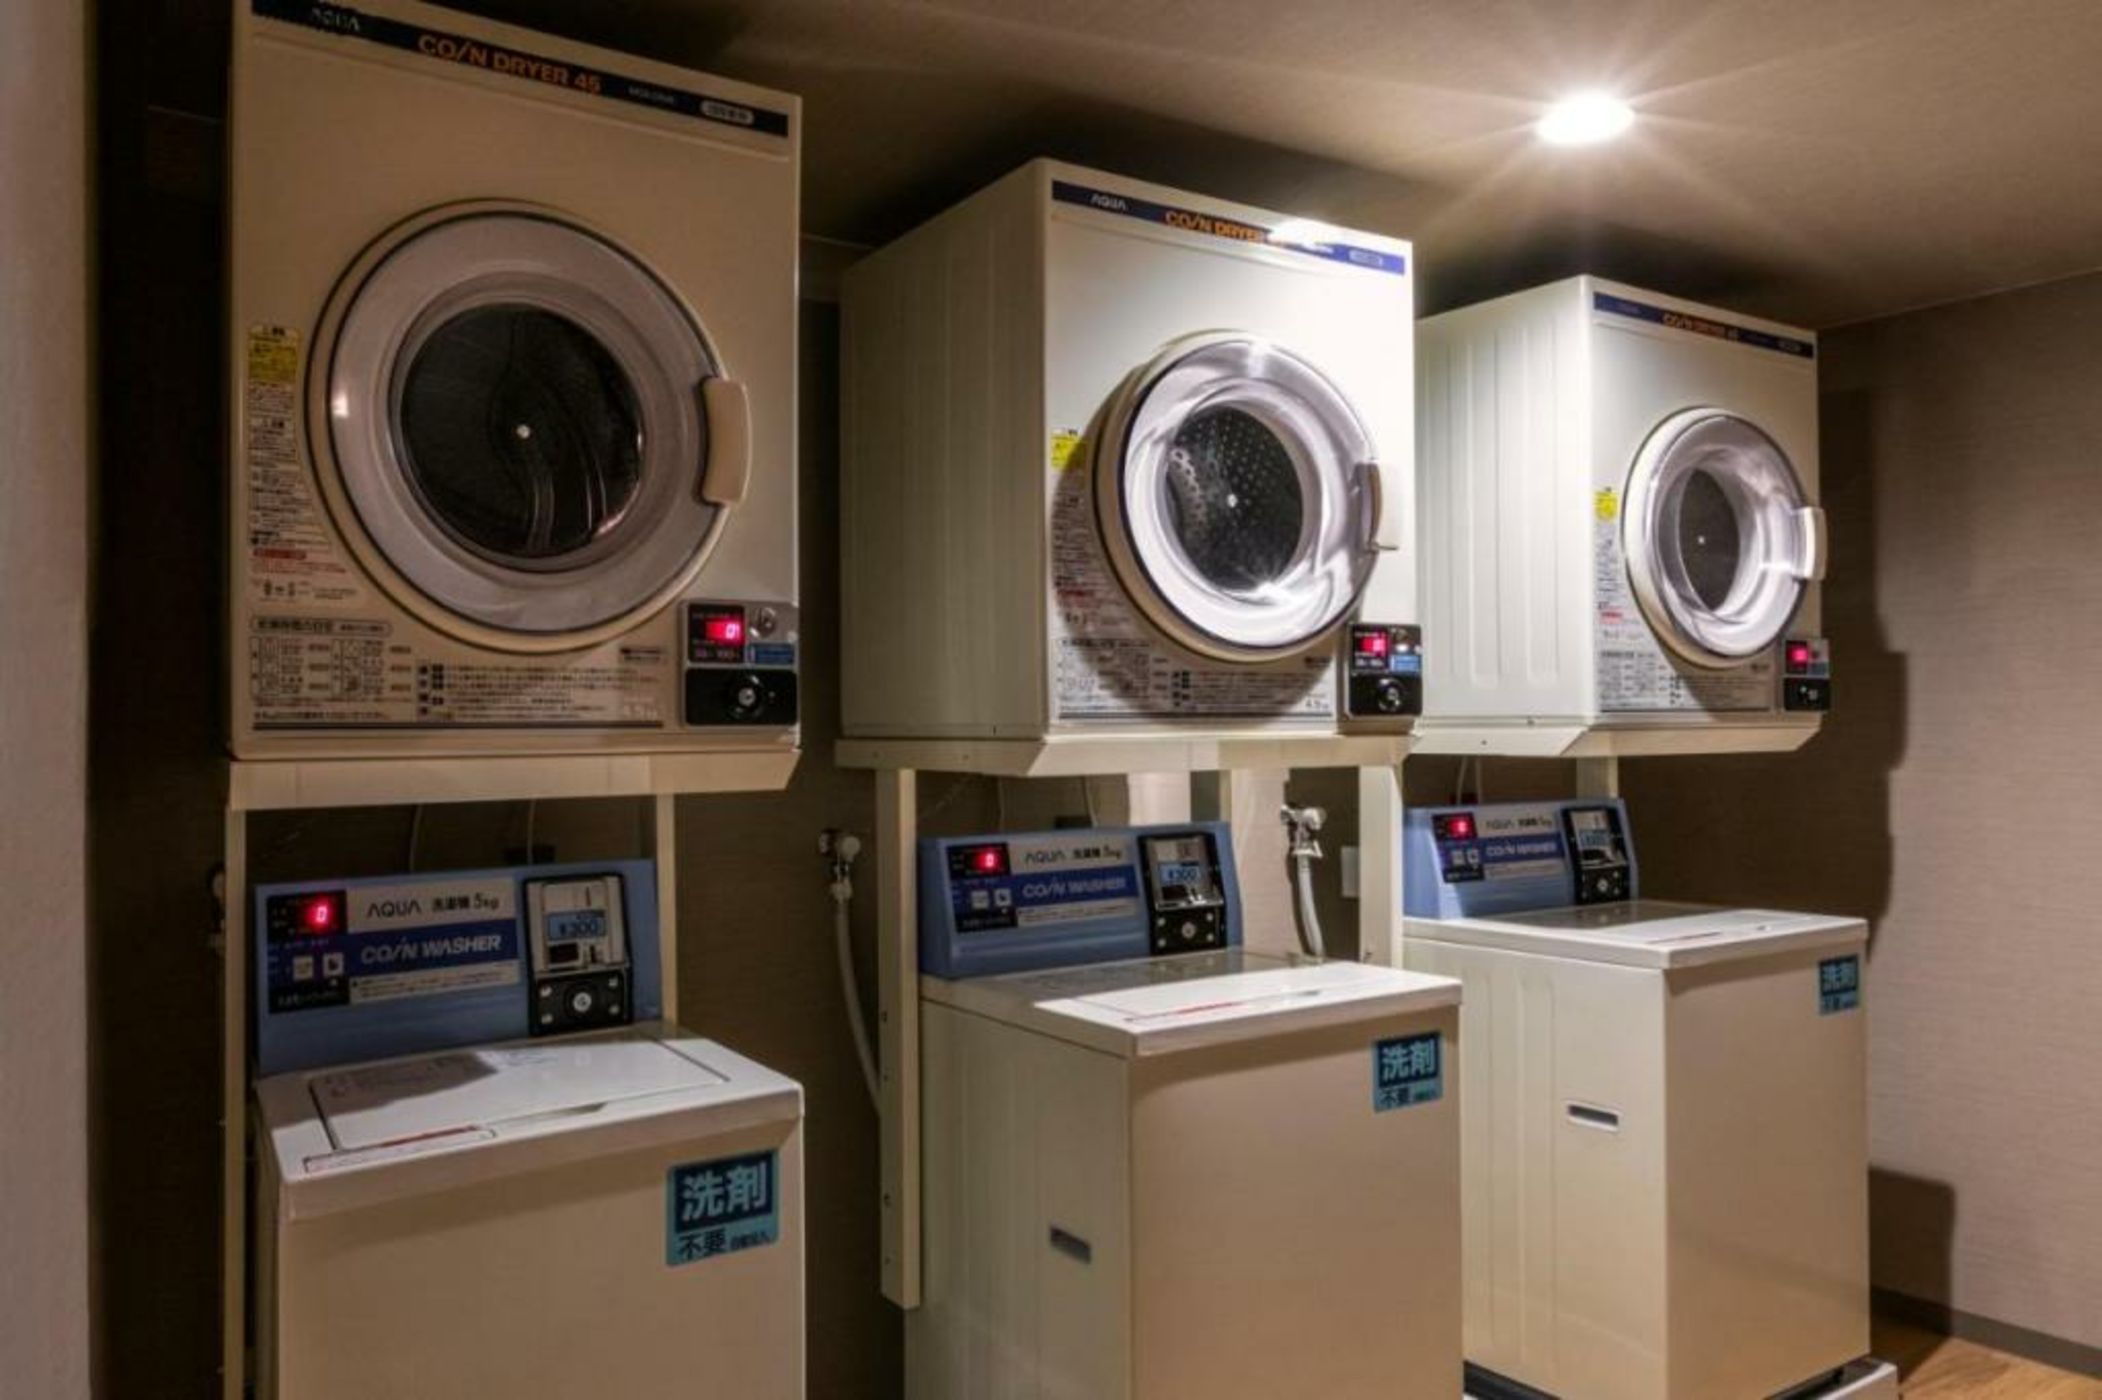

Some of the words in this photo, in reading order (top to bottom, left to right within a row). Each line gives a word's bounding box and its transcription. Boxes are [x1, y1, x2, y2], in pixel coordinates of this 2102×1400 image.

[492, 50, 569, 86] DRYER
[573, 70, 602, 94] 45
[1090, 192, 1128, 211] AQUA
[1025, 849, 1066, 865] AQUA
[366, 899, 422, 919] AQUA
[421, 934, 502, 959] WASHER
[1381, 1038, 1436, 1082] 洗剤
[682, 1161, 768, 1222] 洗剤
[677, 1228, 726, 1260] 不要
